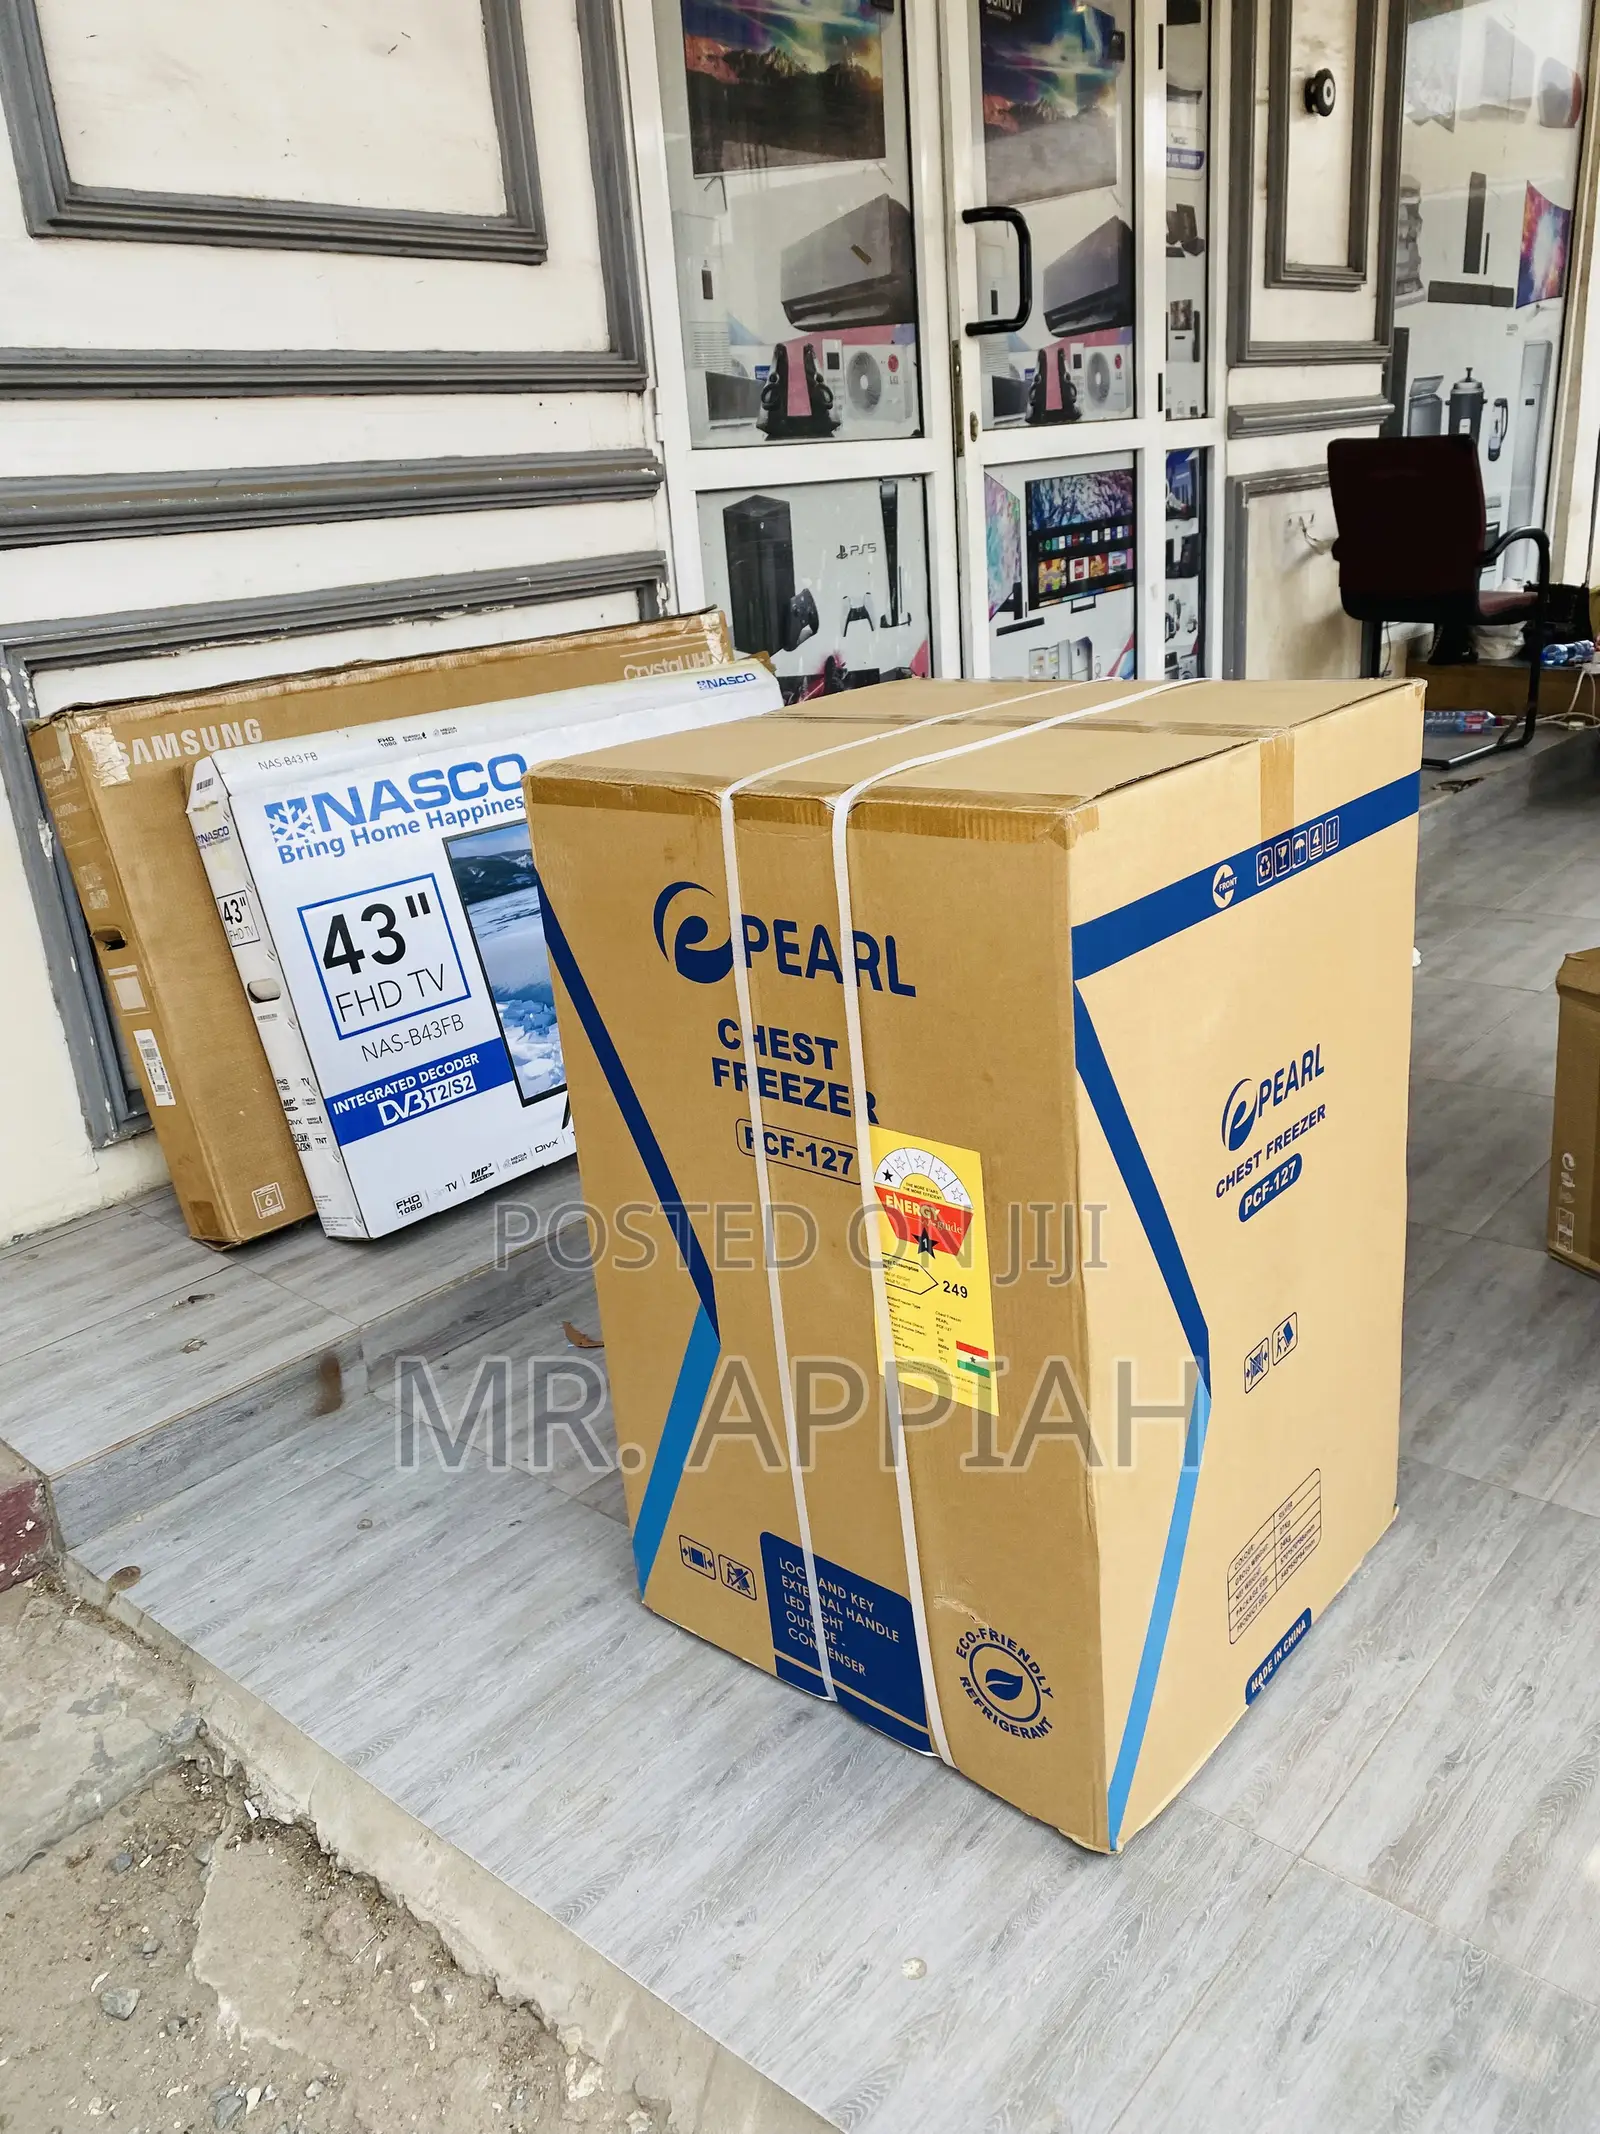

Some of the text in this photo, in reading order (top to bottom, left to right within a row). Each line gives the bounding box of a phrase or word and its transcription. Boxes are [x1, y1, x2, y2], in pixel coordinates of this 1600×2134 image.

[850, 543, 876, 555] PS5
[708, 673, 757, 689] NASCO
[115, 718, 263, 768] SAMSUNG
[311, 753, 528, 832] NASCO
[201, 825, 230, 843] NASCO
[277, 836, 345, 864] Bring
[350, 819, 421, 847] Home
[1218, 876, 1238, 892] FRONT
[223, 897, 246, 925] 43"
[323, 892, 431, 975] 43"
[741, 914, 917, 997] PEARL
[335, 963, 444, 1022] FHD TV
[361, 1014, 465, 1062] NAS-B43FB
[717, 1018, 838, 1070] CHEST
[332, 1053, 480, 1115] INTEGRATED DECODER
[711, 1057, 880, 1125] FREEZER
[1258, 1043, 1325, 1118] PEARL
[1215, 1103, 1326, 1199] CHEST FREEZER
[396, 1194, 421, 1209] FHD
[398, 1202, 423, 1216] 1080
[885, 1192, 941, 1220] ENERGY
[1244, 1160, 1297, 1216] PCF-127
[942, 1280, 968, 1299] 249
[781, 1575, 900, 1643] EXTENAL HANDLE
[783, 1592, 844, 1631] LED LGHT
[818, 1577, 847, 1599] AND
[850, 1592, 875, 1613] KEY
[786, 1610, 838, 1645] OUTSDE
[788, 1627, 867, 1677] CONENSER
[955, 1627, 1054, 1699] ECO-FRIENDLY
[1251, 1619, 1307, 1693] MADE IN CHINA
[959, 1675, 1054, 1740] REFRIGERANT
